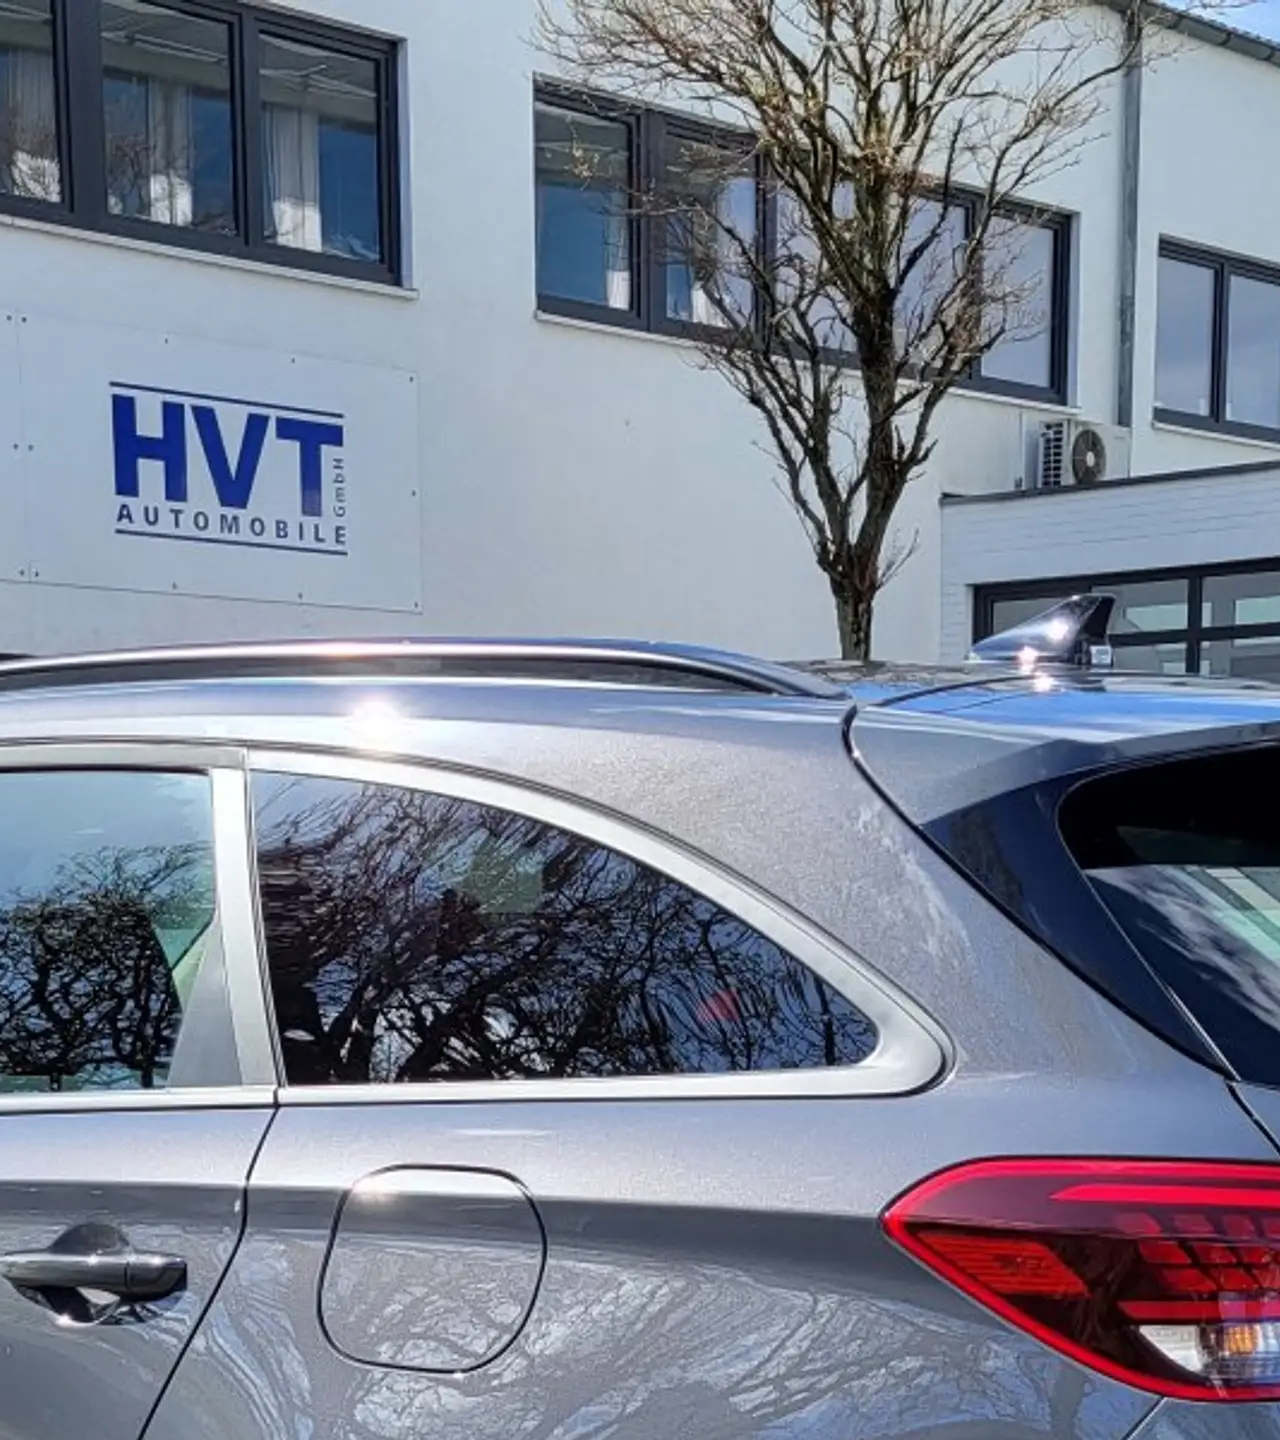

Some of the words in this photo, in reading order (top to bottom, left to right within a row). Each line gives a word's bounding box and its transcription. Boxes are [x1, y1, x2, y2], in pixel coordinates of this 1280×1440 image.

[111, 393, 344, 517] HVT
[332, 458, 346, 518] GmbH
[116, 503, 347, 545] AUTOMOBILE
